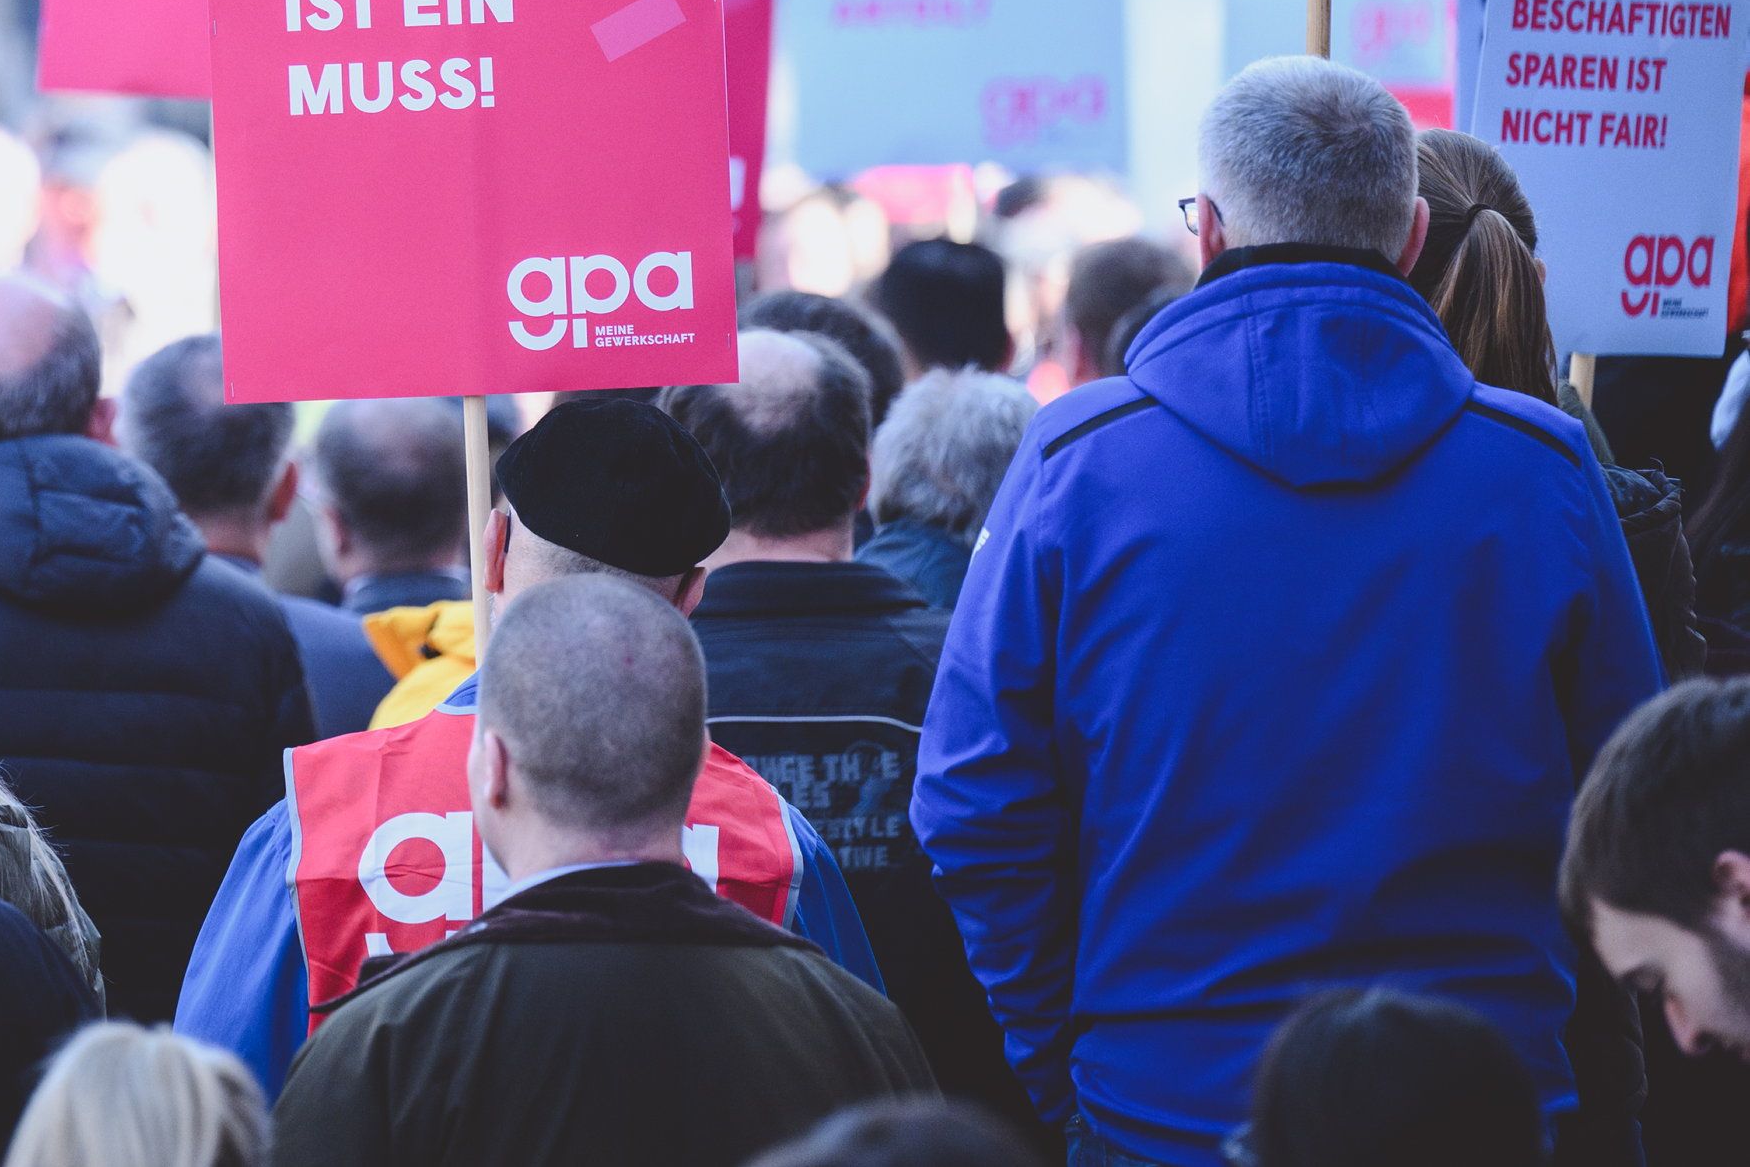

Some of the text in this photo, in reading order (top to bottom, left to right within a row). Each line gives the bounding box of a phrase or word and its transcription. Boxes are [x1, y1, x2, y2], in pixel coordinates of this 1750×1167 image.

[287, 56, 496, 116] MUSS!
[1505, 53, 1668, 93] SPAREN IST
[1500, 108, 1669, 149] NICHT FAIR!
[1621, 233, 1715, 318] gpa
[506, 251, 695, 351] gpa
[595, 324, 635, 336] MEINE
[595, 333, 695, 348] GEWERKSCHAFT
